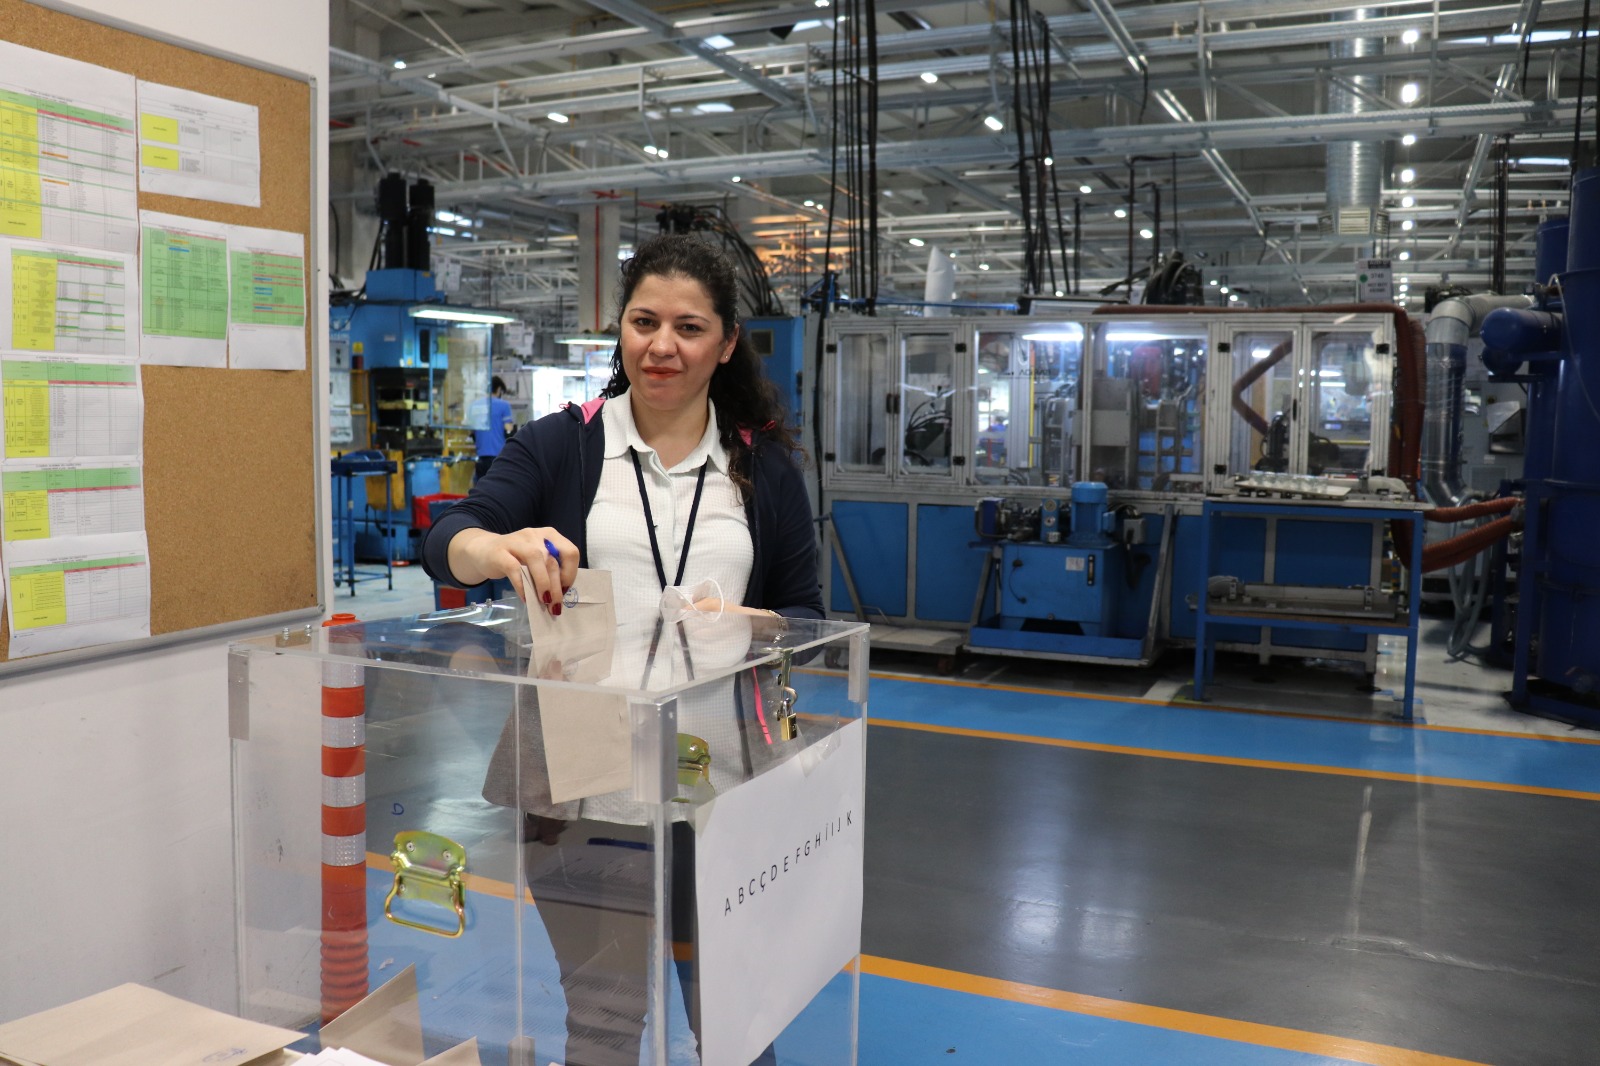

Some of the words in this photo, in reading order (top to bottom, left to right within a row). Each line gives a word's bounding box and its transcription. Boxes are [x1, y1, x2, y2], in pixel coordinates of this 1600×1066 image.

[725, 897, 732, 916] A
[738, 887, 744, 905] B
[748, 878, 756, 896] C
[760, 871, 766, 892] Ç
[771, 864, 778, 882] D
[784, 856, 789, 873] E
[795, 847, 801, 864] F
[804, 840, 811, 857] G
[815, 832, 821, 848] H
[847, 810, 852, 826] K
